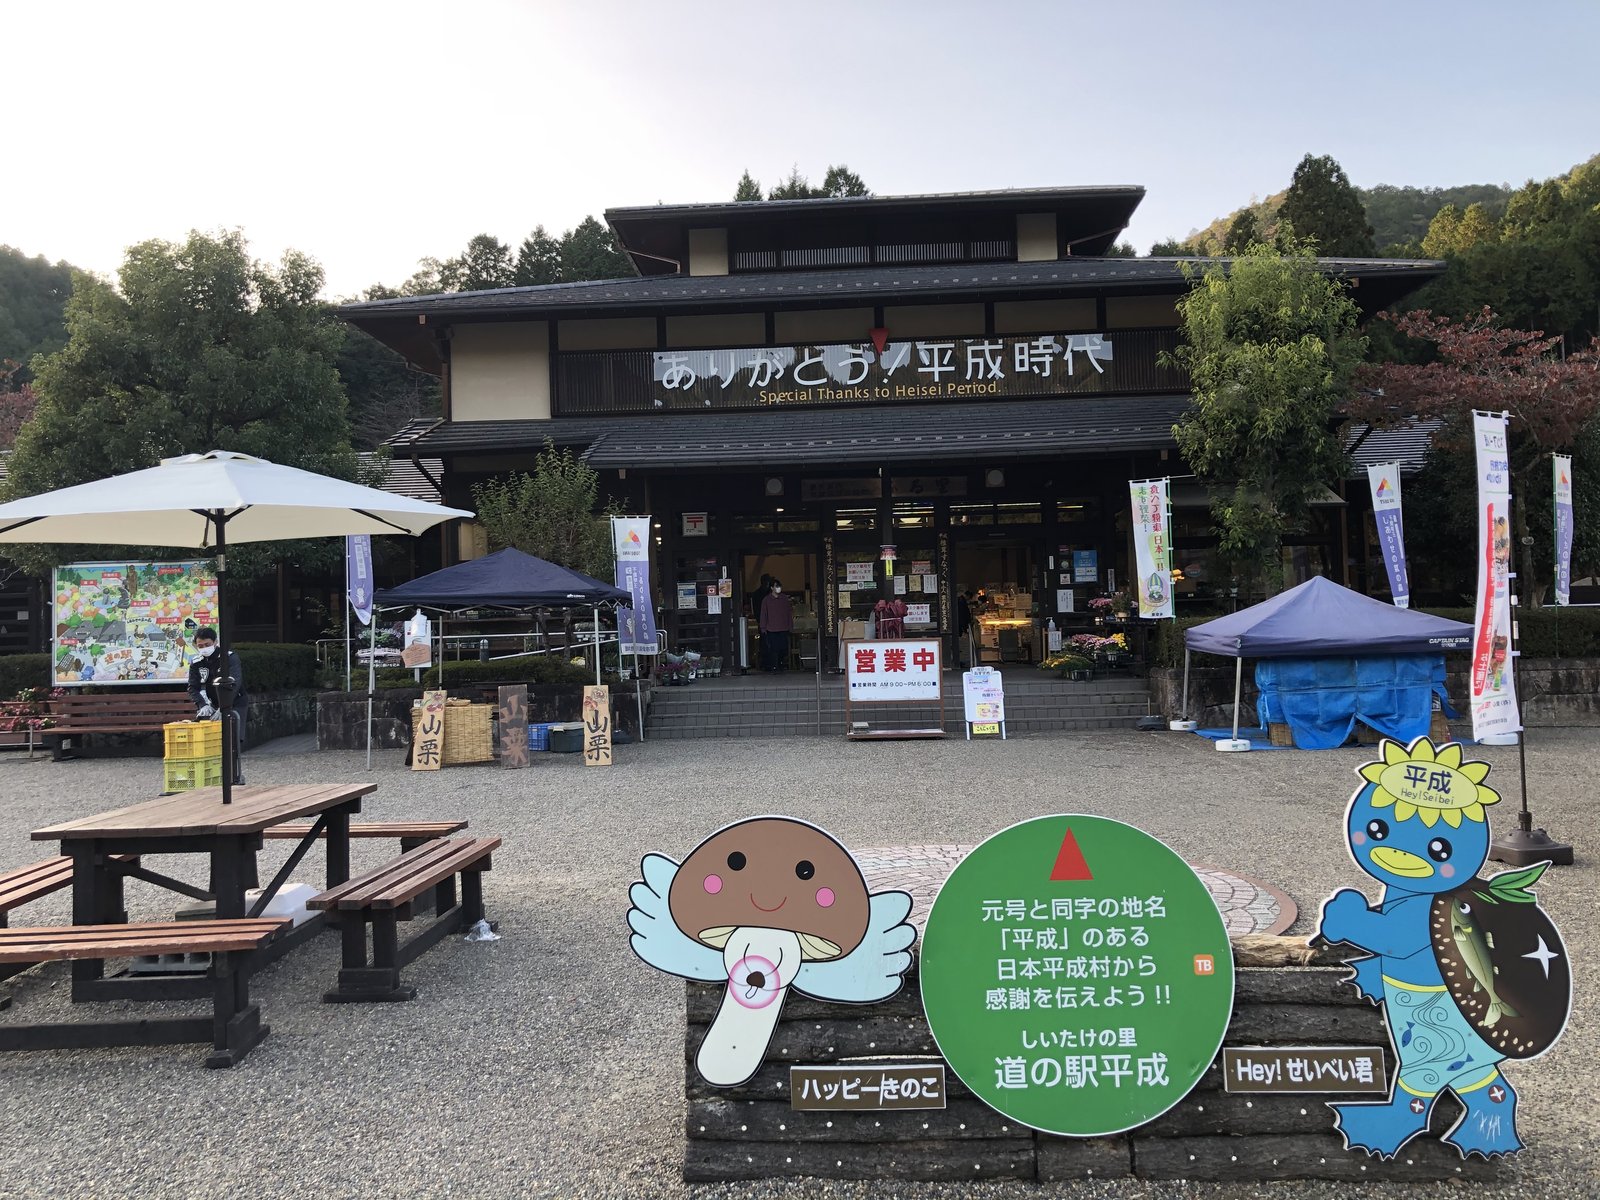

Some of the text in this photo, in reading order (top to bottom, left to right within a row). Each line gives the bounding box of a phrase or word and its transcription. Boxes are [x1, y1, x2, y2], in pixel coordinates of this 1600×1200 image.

[760, 380, 1001, 403] Special Thanks to Heisei Period.
[104, 648, 169, 665] 道の駅 平成
[855, 648, 935, 673] 営業中
[417, 714, 441, 766] 山栗
[586, 709, 610, 761] 山栗
[1403, 764, 1453, 795] 平成
[1401, 788, 1455, 806] Hey!Seibei
[982, 896, 1167, 922] 元号と同字の地名
[1001, 926, 1149, 951] 「平成」のある
[997, 955, 1157, 981] 日本平成村から
[1195, 959, 1213, 972] TB
[1022, 1027, 1138, 1049] しいたけの里
[995, 1052, 1170, 1089] 道の駅平成
[1236, 1056, 1374, 1084] Hey! せいべい君
[801, 1077, 939, 1101] ハッピーきのこ
